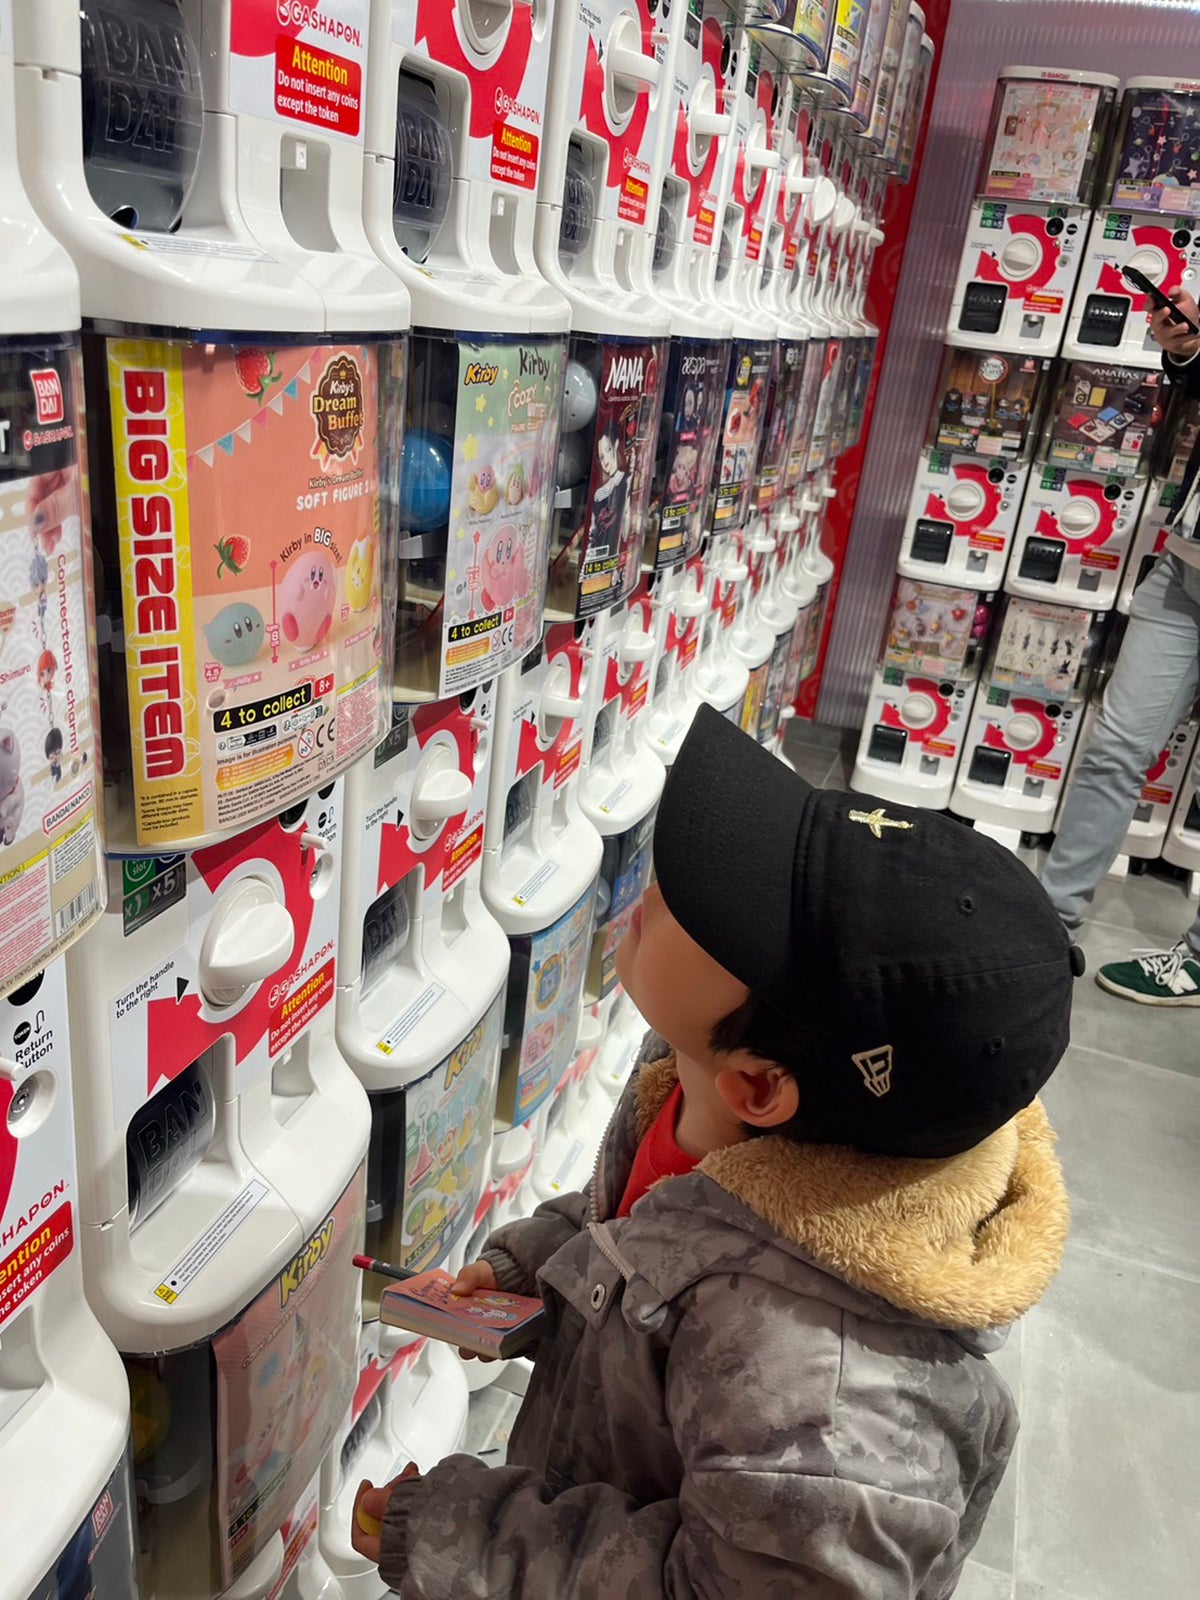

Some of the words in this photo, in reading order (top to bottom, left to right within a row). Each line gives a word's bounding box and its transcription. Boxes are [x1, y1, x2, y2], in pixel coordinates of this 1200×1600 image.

[292, 45, 348, 86] Attention
[278, 70, 290, 86] Do
[291, 77, 304, 92] not
[305, 79, 326, 100] insert
[327, 89, 341, 107] any
[341, 94, 359, 109] coins
[277, 95, 304, 115] except
[304, 101, 318, 115] the
[318, 105, 340, 123] token
[501, 128, 531, 154] Attention
[464, 362, 499, 386] Kirby
[519, 346, 550, 382] Kirby
[604, 355, 644, 394] NANA
[36, 379, 60, 397] BAN
[313, 396, 357, 414] Dream
[330, 380, 354, 397] Kirby's
[40, 398, 59, 416] DAI
[122, 370, 170, 482] BIG
[296, 491, 329, 511] SOFT
[333, 482, 363, 503] FIGURE
[280, 538, 302, 562] Kirby
[304, 533, 312, 544] in
[313, 527, 332, 548] BIG
[131, 496, 178, 635] SIZE
[271, 631, 278, 640] 8
[451, 627, 458, 640] 4
[461, 626, 471, 637] to
[473, 615, 500, 634] collect
[58, 554, 74, 685] Connectable
[66, 688, 80, 754] charm!
[319, 681, 331, 693] 8+
[139, 646, 186, 779] ITEM
[220, 711, 231, 729] 4
[238, 708, 256, 725] to
[263, 690, 306, 718] collect
[132, 861, 147, 877] slot
[280, 939, 334, 995] GASHAPON
[115, 991, 135, 1008] Turn
[135, 981, 149, 994] the
[150, 961, 174, 984] handle
[116, 1009, 125, 1019] to
[126, 998, 139, 1011] the
[140, 982, 158, 1001] right
[281, 972, 325, 1020] Attention
[270, 1027, 280, 1040] Do
[281, 1017, 292, 1029] not
[270, 1031, 292, 1052] except
[15, 1030, 53, 1063] Return
[20, 1042, 53, 1069] utton
[0, 1179, 65, 1249] HAPON
[23, 1254, 42, 1278] any
[44, 1227, 70, 1257] coins
[279, 1217, 335, 1311] Kirby
[13, 1270, 43, 1303] token
